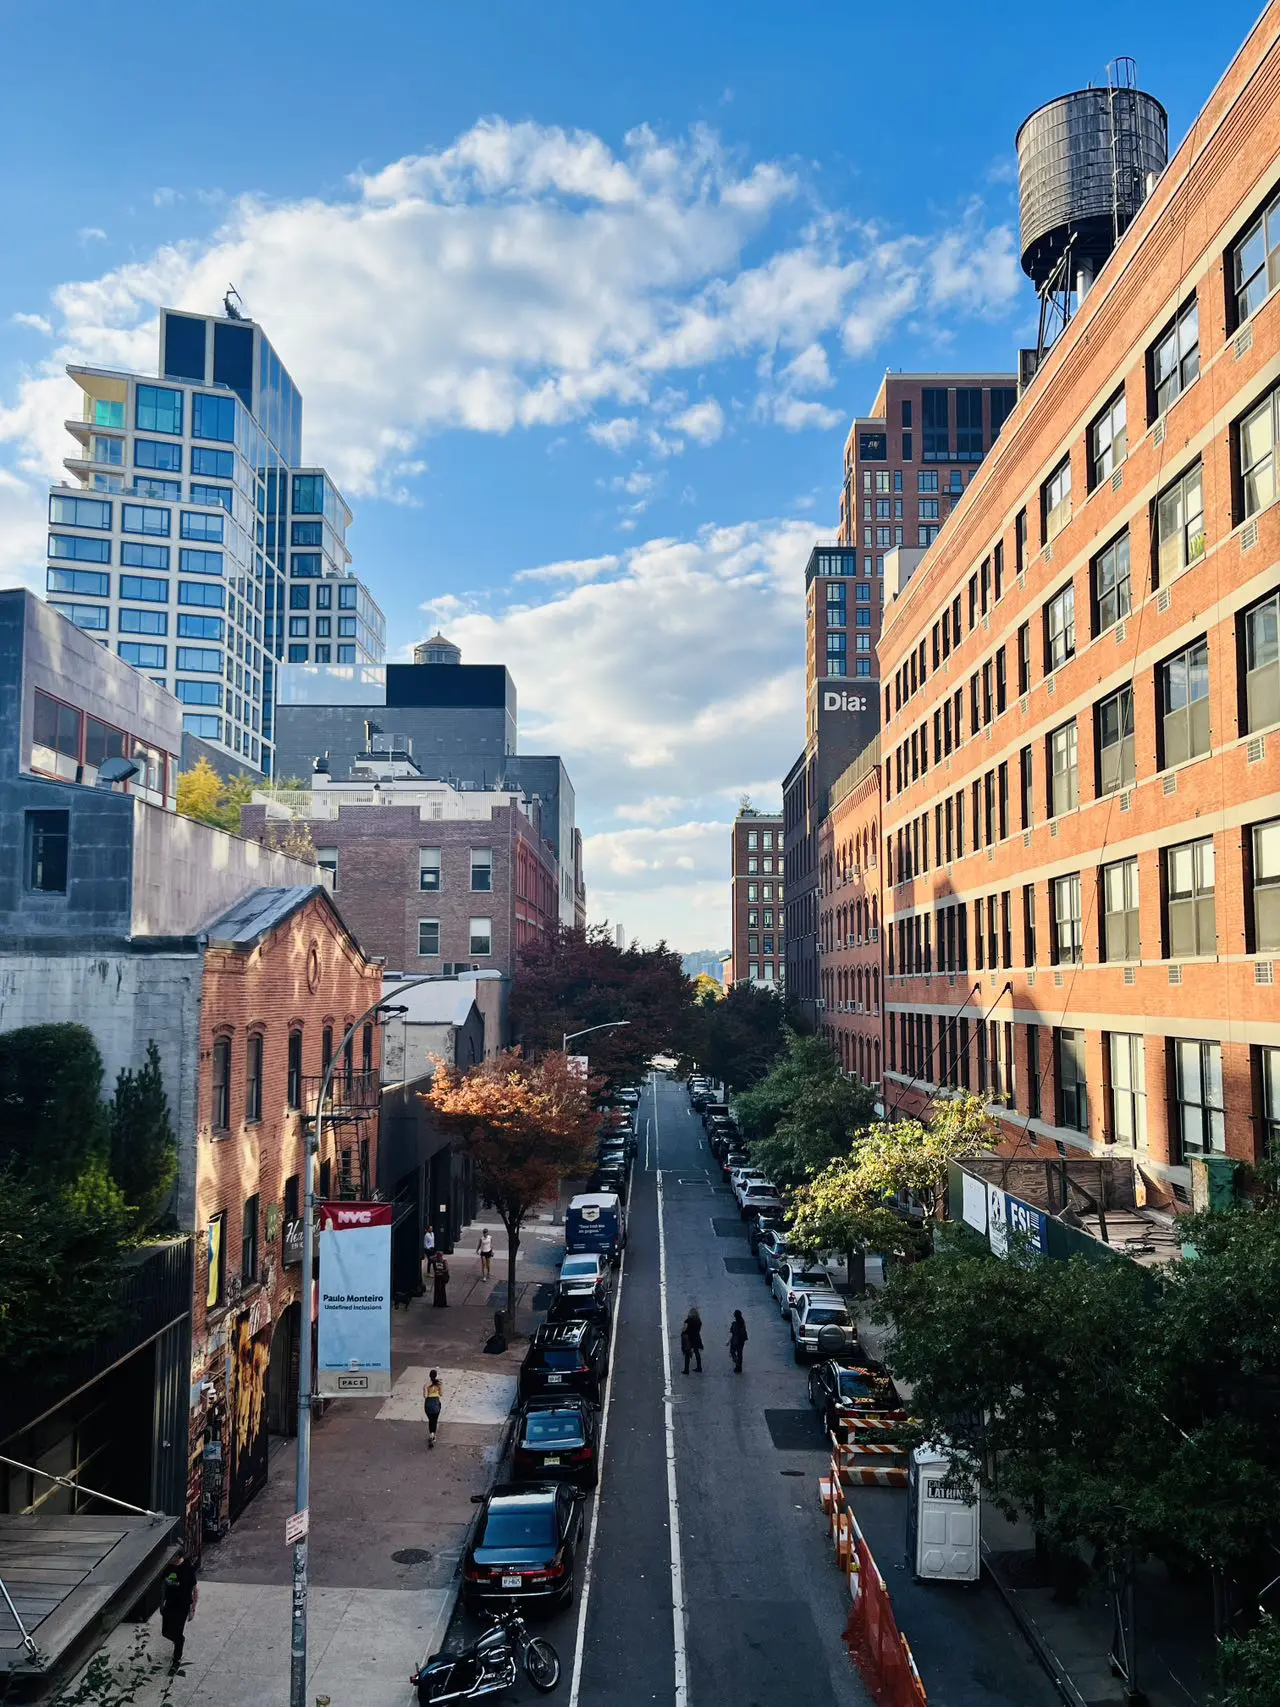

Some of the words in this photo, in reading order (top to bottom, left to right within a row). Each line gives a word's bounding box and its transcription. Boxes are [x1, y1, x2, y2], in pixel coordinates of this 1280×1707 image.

[824, 691, 867, 712] Dia:
[338, 1211, 371, 1223] NYC
[323, 1294, 345, 1302] Paulo
[346, 1294, 384, 1302] Monteiro
[929, 1488, 966, 1499] LATRIN
